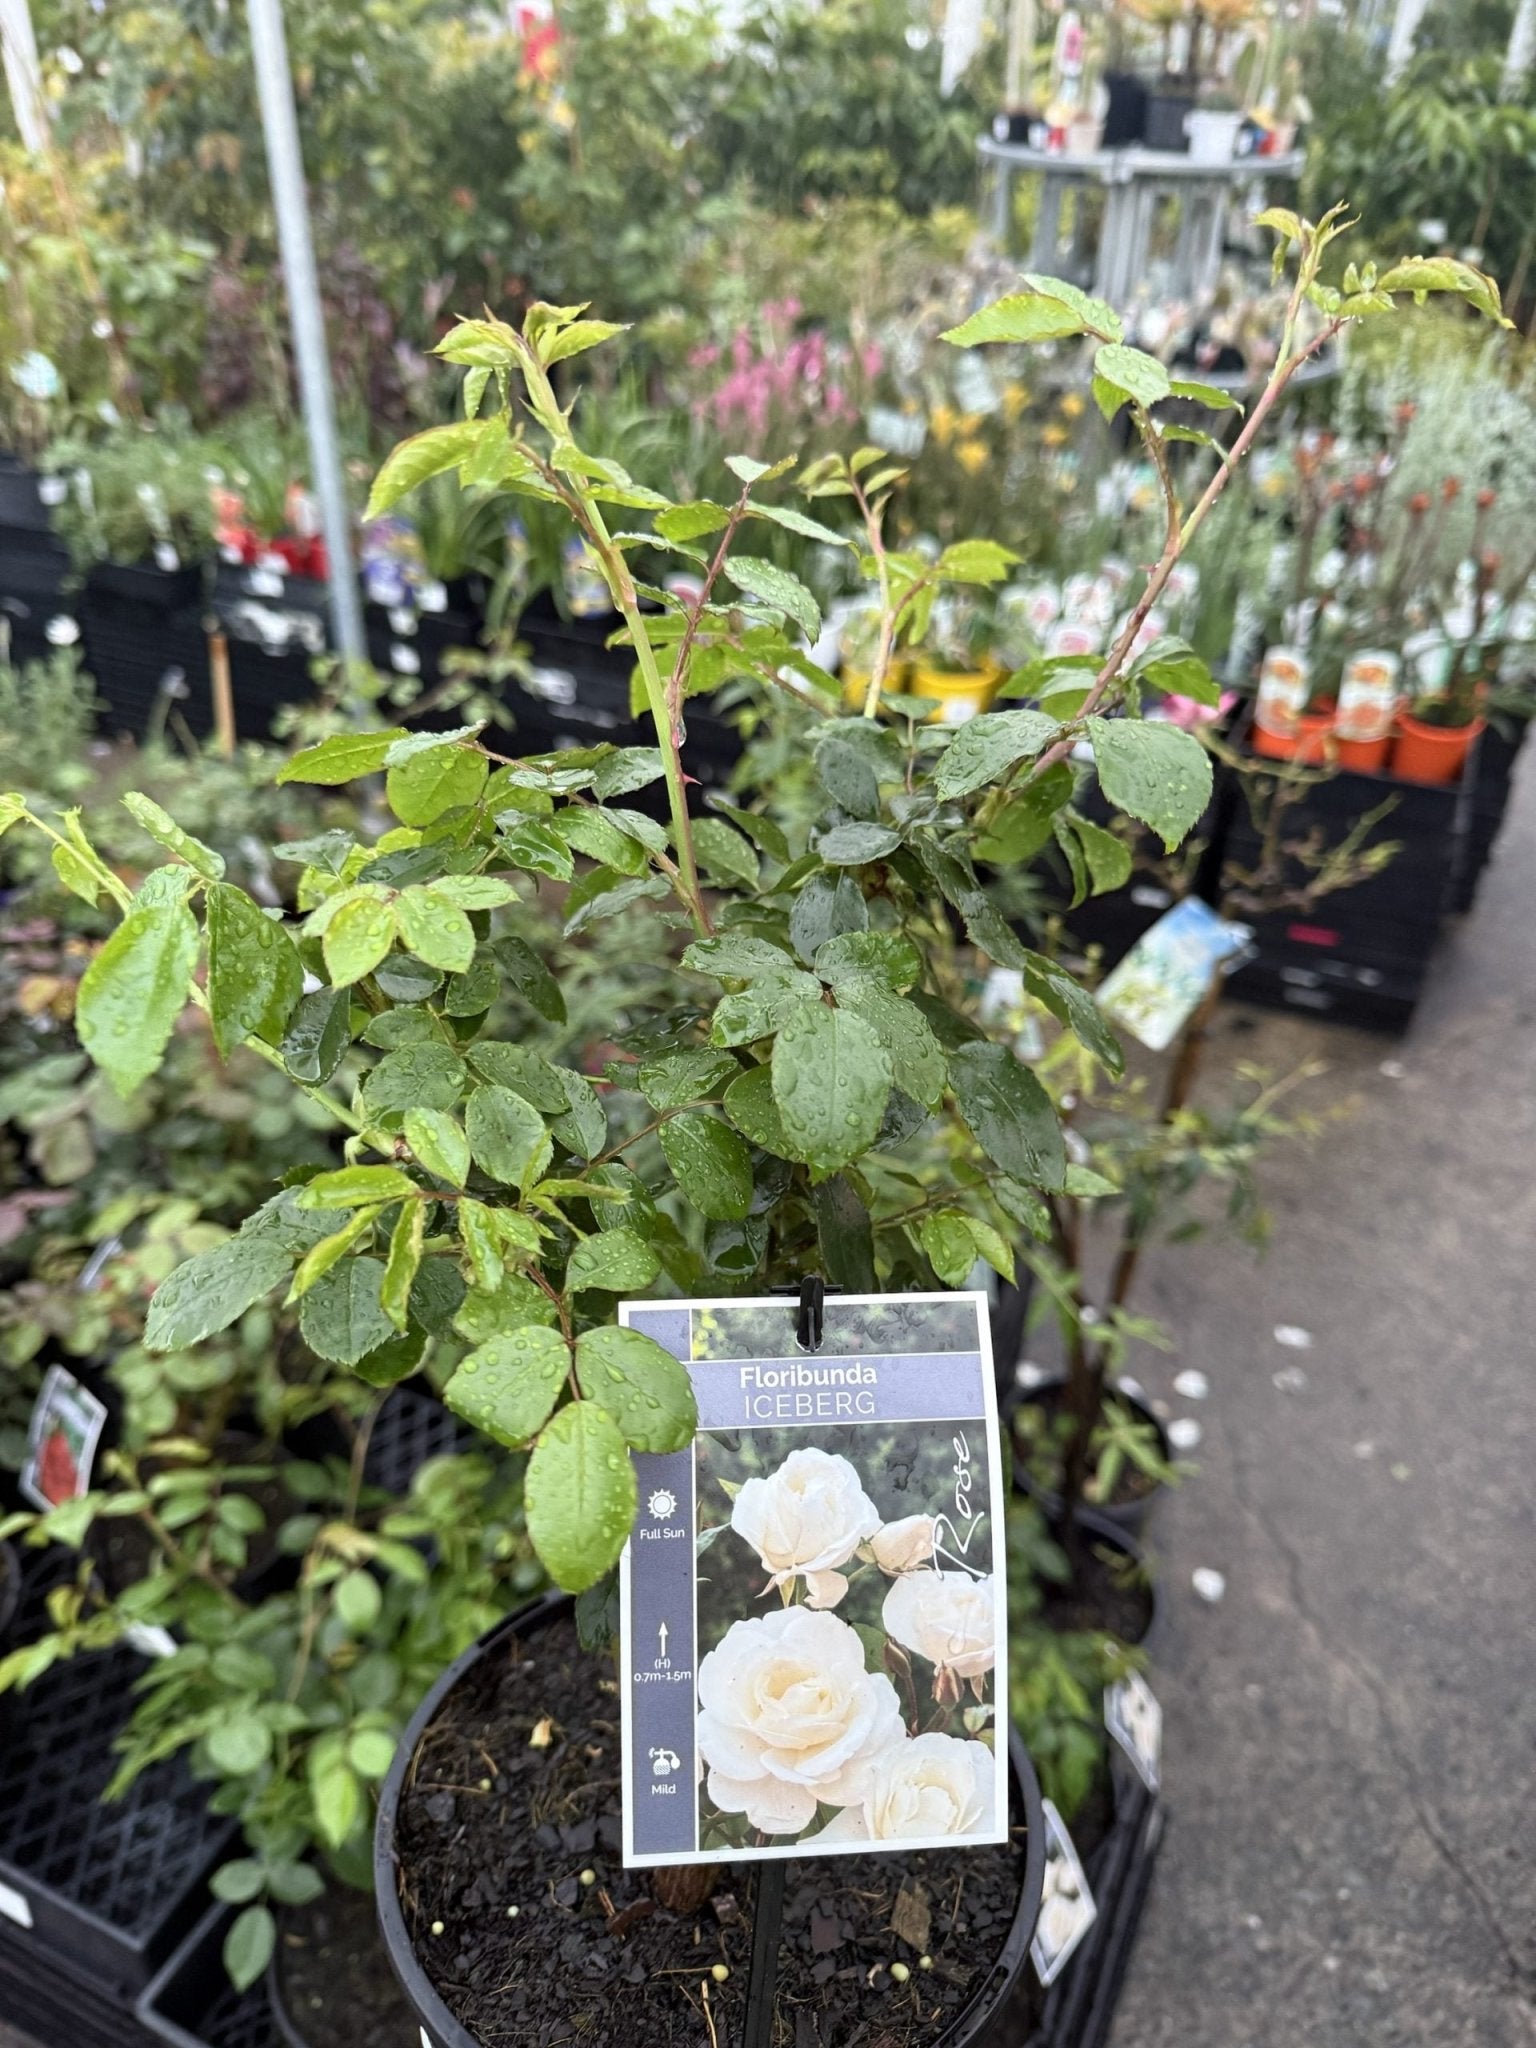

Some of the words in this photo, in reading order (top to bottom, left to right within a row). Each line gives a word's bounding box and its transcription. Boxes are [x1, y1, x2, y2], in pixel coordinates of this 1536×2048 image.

[739, 1362, 878, 1389] Floribunda
[743, 1391, 876, 1418] ICEBERG
[932, 1430, 987, 1579] Rose
[640, 1529, 661, 1540] Full
[663, 1528, 685, 1538] Sun
[654, 1658, 671, 1669] (H)
[633, 1671, 692, 1683] 0.7m-1.5m
[651, 1784, 677, 1795] Mild
